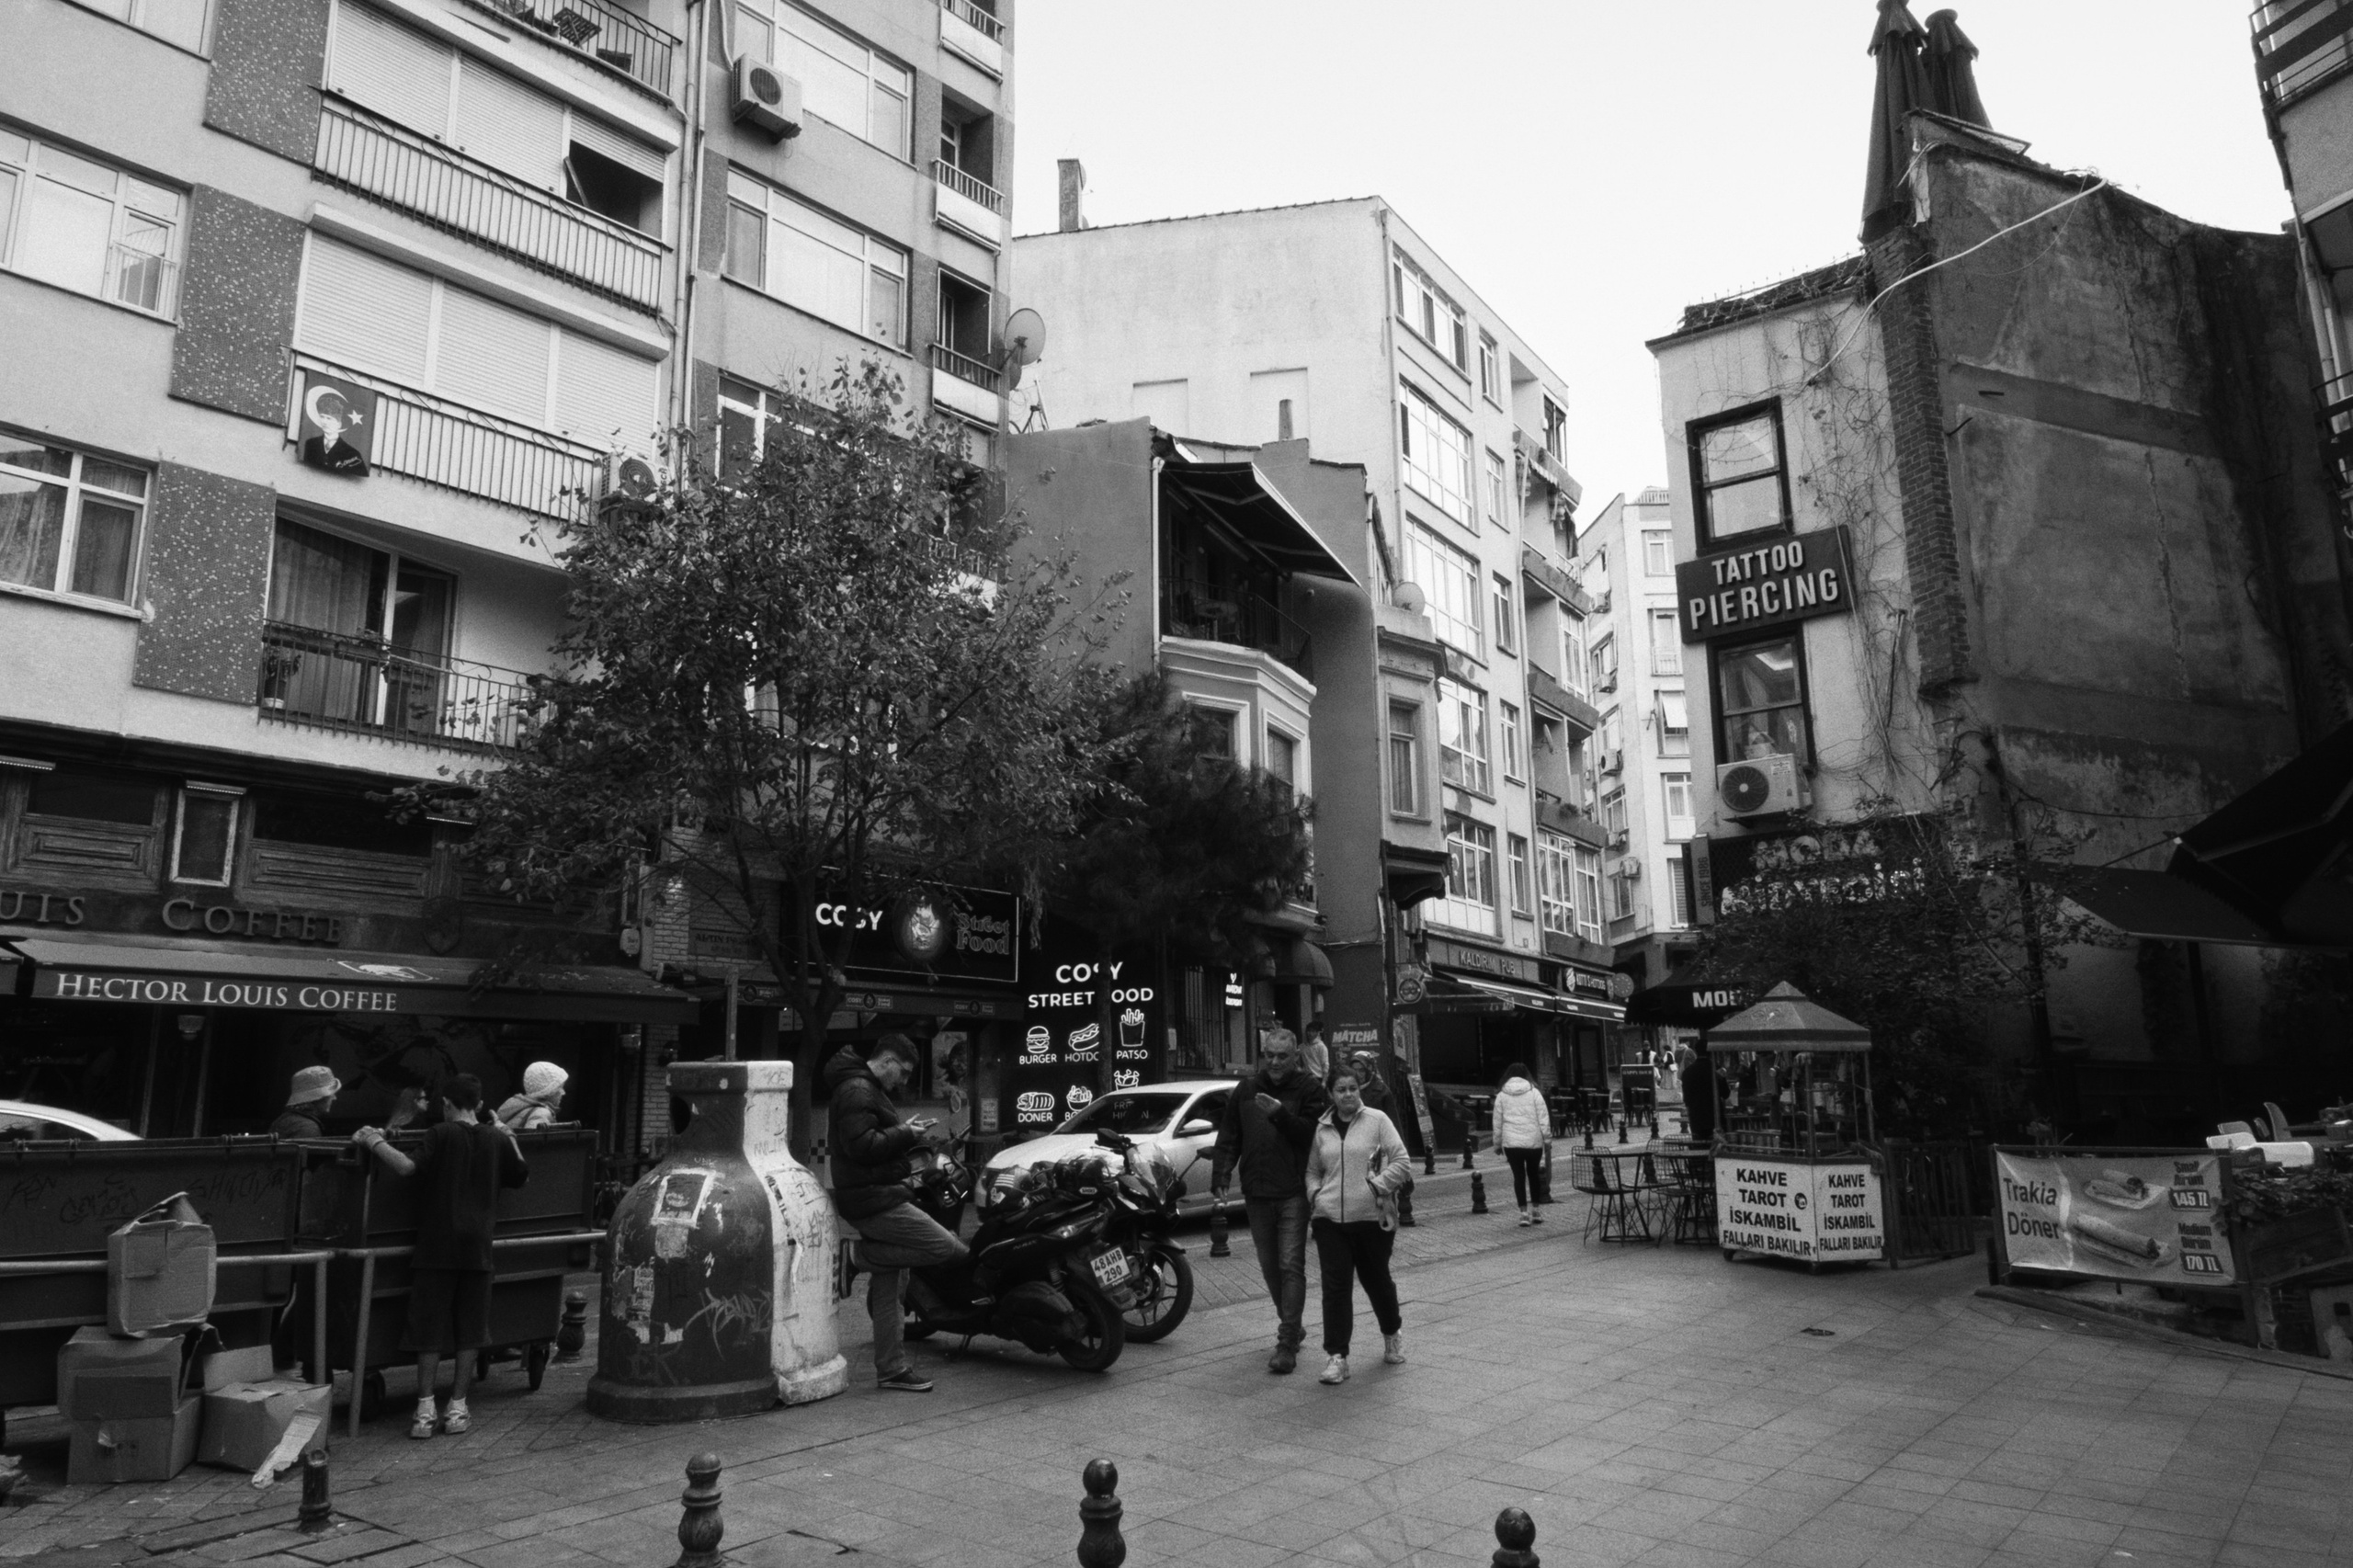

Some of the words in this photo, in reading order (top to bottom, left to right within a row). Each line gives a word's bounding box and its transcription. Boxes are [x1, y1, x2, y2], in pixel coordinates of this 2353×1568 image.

[1711, 540, 1804, 585] TATTOO
[1688, 567, 1839, 631] PIERCING
[162, 898, 342, 943] COFFEE
[956, 928, 1010, 955] Food
[1055, 960, 1124, 984] COY
[1501, 959, 1516, 975] PUB
[55, 972, 190, 1004] HECTOR
[203, 981, 289, 1009] LOUIS
[298, 986, 398, 1012] COFFEE
[1028, 991, 1097, 1009] STREET
[1109, 986, 1154, 1005] OOD
[1332, 1028, 1379, 1044] MATCHA
[1018, 1052, 1058, 1065] BURGER
[1115, 1049, 1150, 1061] PATSO
[1017, 1110, 1054, 1123] DONER
[1736, 1168, 1788, 1187] KAHVE
[1828, 1174, 1866, 1188] KAHVE
[1738, 1188, 1788, 1208] TAROT
[2004, 1177, 2058, 1206] Trakia
[2173, 1191, 2196, 1207] 145
[2197, 1191, 2209, 1207] TL
[1831, 1194, 1866, 1209] TAROT
[1729, 1206, 1802, 1233] İSKAMBİL
[1824, 1212, 1875, 1230] İSKAMBİL
[2006, 1211, 2060, 1239] Döner
[2178, 1222, 2212, 1237] Medium
[1722, 1229, 1765, 1250] FALLARI
[1767, 1235, 1812, 1256] BAKILIR
[1819, 1236, 1851, 1252] FALLARI
[1852, 1235, 1881, 1251] BAKILIR
[2186, 1255, 2203, 1270] 170
[2204, 1256, 2220, 1272] TL
[1104, 1265, 1123, 1283] 290
